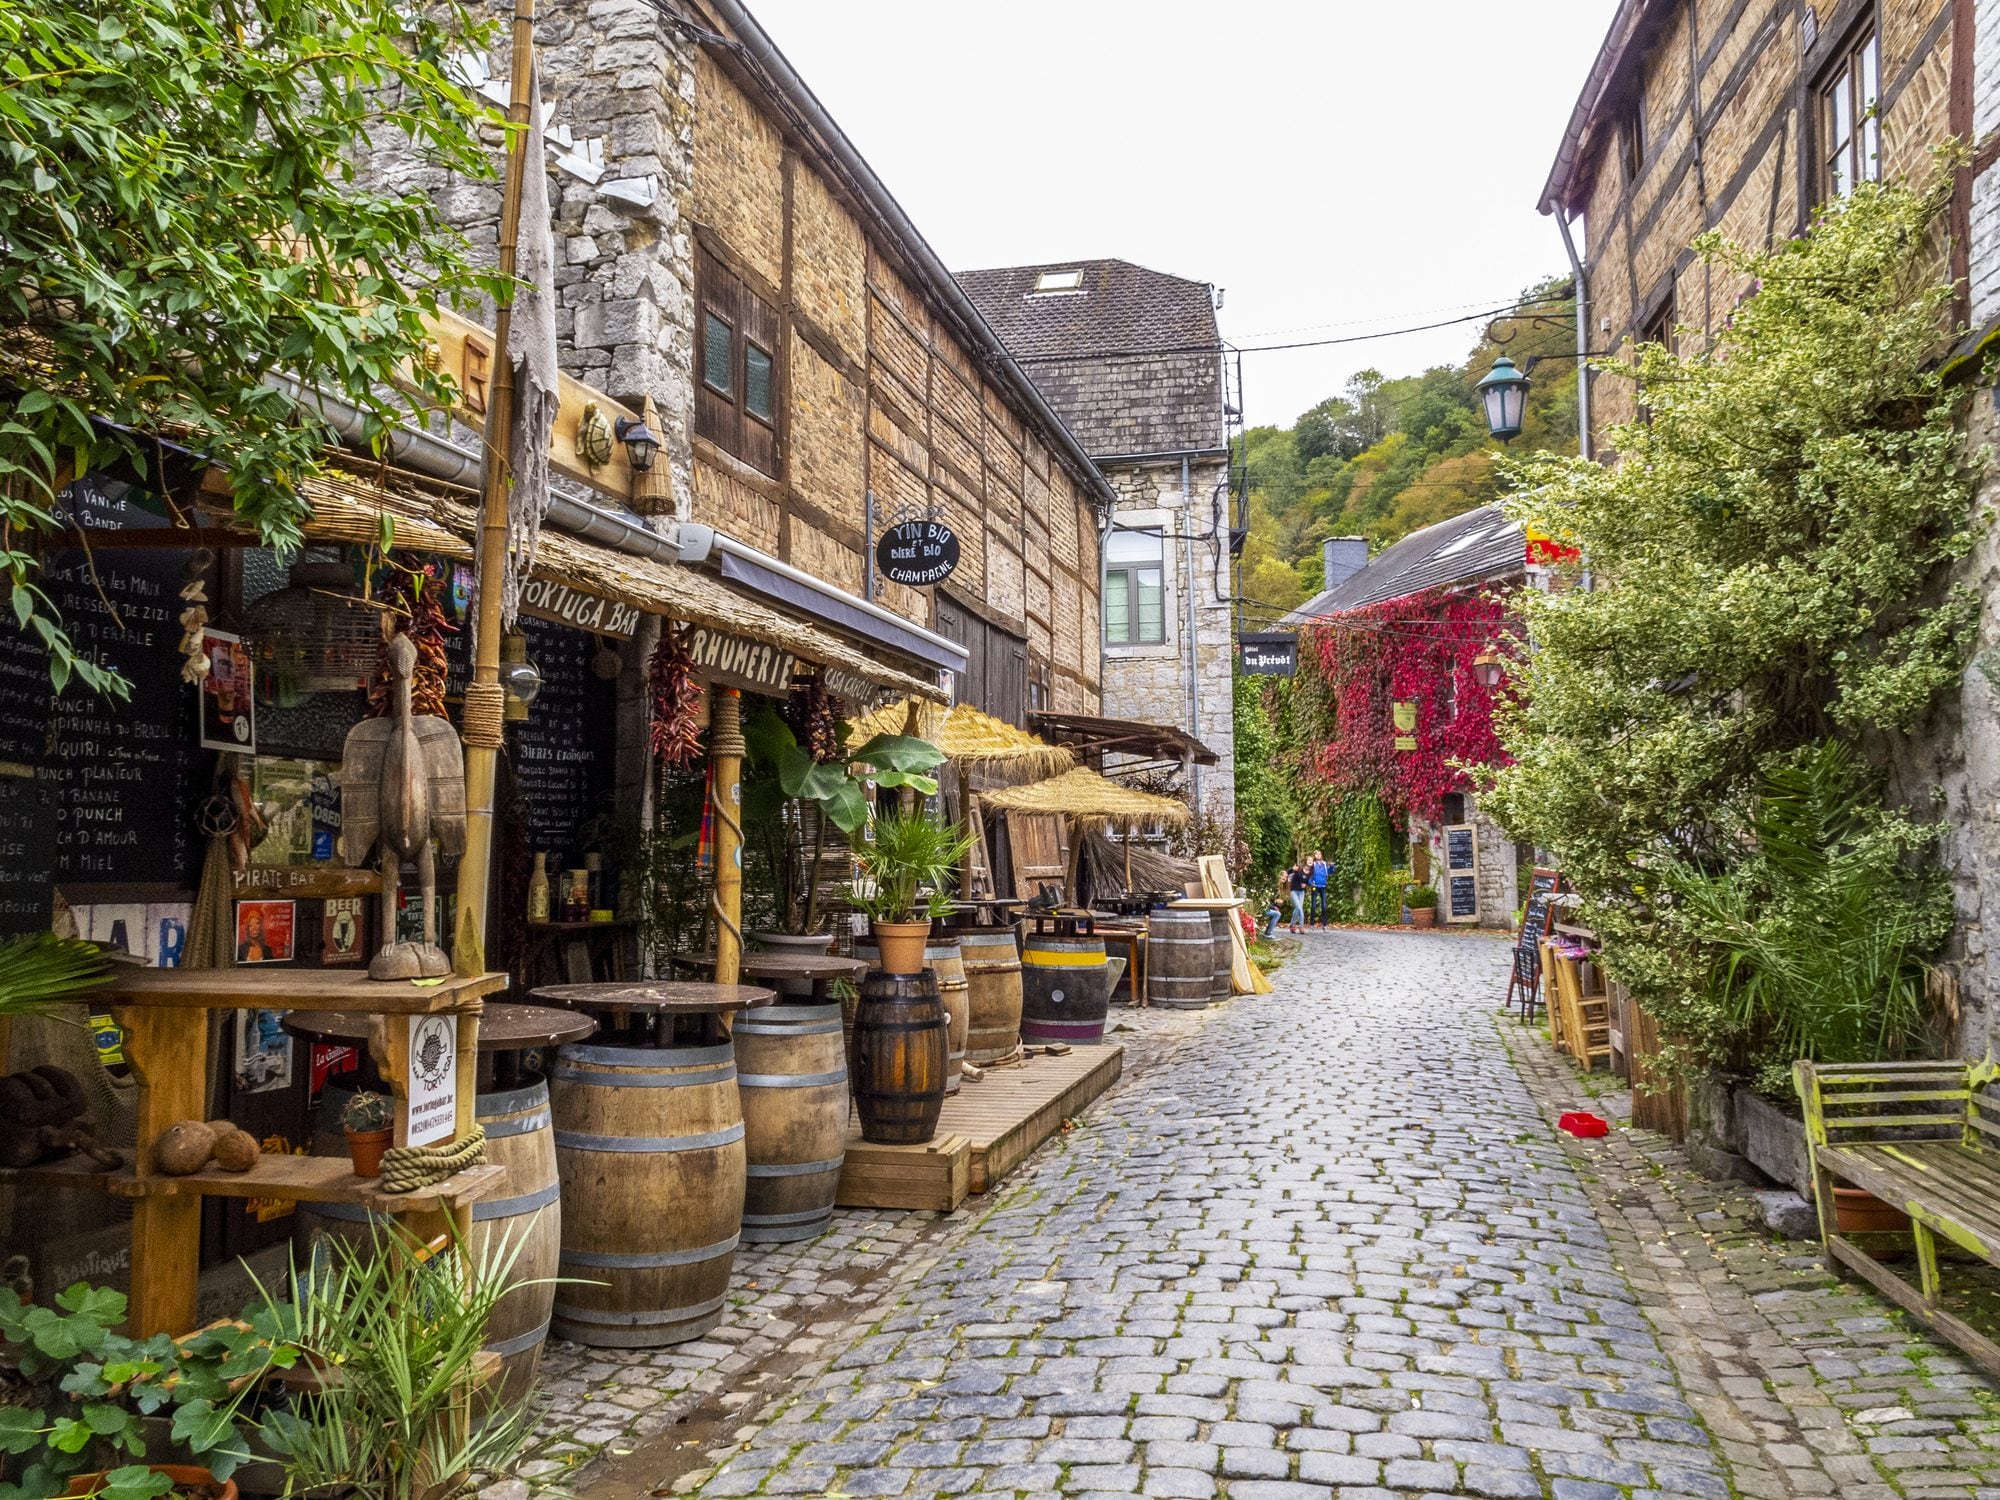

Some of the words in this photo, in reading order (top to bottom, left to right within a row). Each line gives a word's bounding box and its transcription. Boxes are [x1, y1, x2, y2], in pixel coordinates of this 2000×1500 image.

[912, 539, 924, 547] ET
[927, 523, 951, 545] BIO
[923, 543, 942, 557] BIO
[890, 559, 953, 583] CHAMPAGNE
[605, 601, 641, 638] BAR
[691, 629, 797, 692] RHUMERIE
[1245, 655, 1258, 666] du
[824, 667, 846, 693] CASA
[50, 695, 95, 714] PUNCH
[80, 761, 144, 788] PLANTEUR
[73, 807, 124, 829] PUNCH
[232, 868, 283, 889] PIRATE
[289, 870, 316, 887] BAR
[325, 897, 363, 917] BEER
[316, 1053, 325, 1067] La
